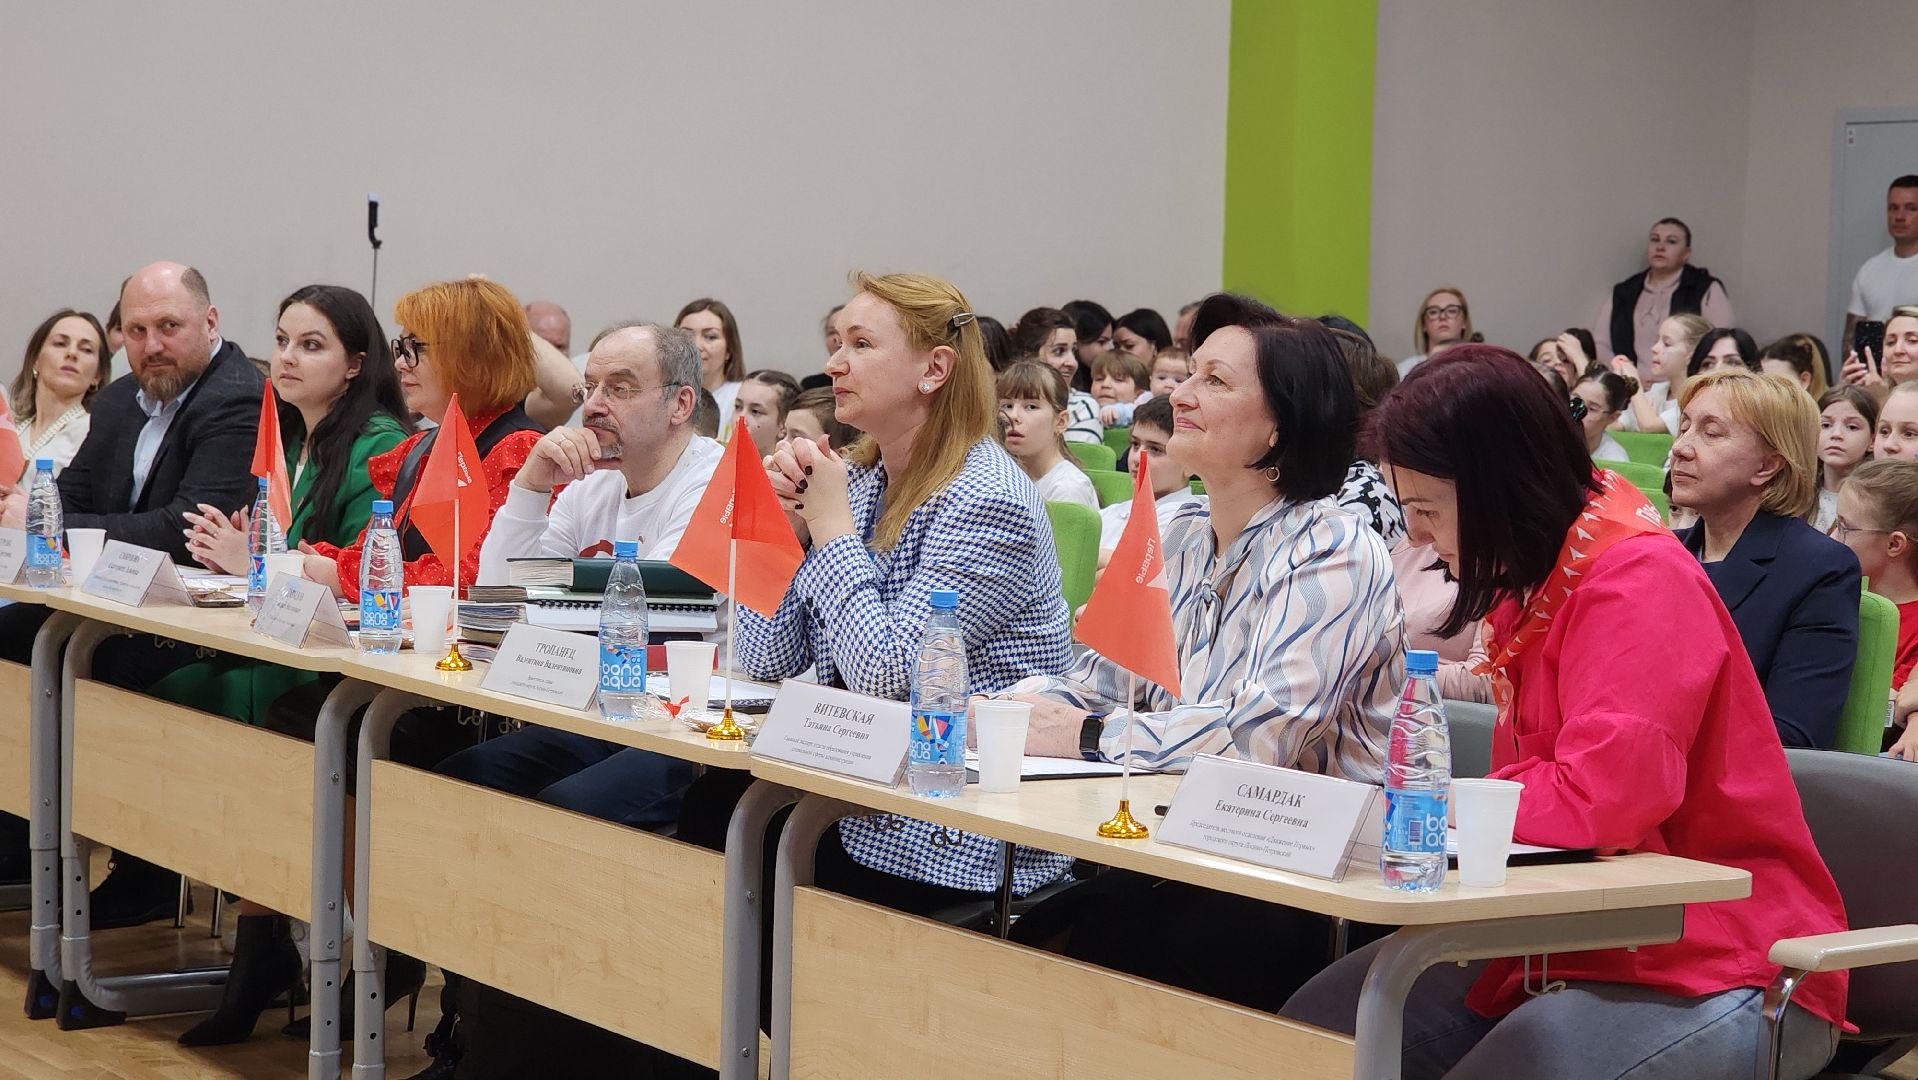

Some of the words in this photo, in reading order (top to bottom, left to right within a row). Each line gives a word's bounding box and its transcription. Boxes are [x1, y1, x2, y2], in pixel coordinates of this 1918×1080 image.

[535, 642, 577, 660] ТРОПАНЕЦ
[602, 660, 641, 676] bona
[602, 675, 641, 690] aqua
[813, 702, 876, 726] ВИТЕВСКАЯ
[803, 717, 832, 733] Татьяна
[832, 724, 870, 741] Сергеевна
[1237, 783, 1307, 809] САМАРДАК
[1215, 799, 1261, 819] Екатерина
[1262, 809, 1310, 828] Сергеевна
